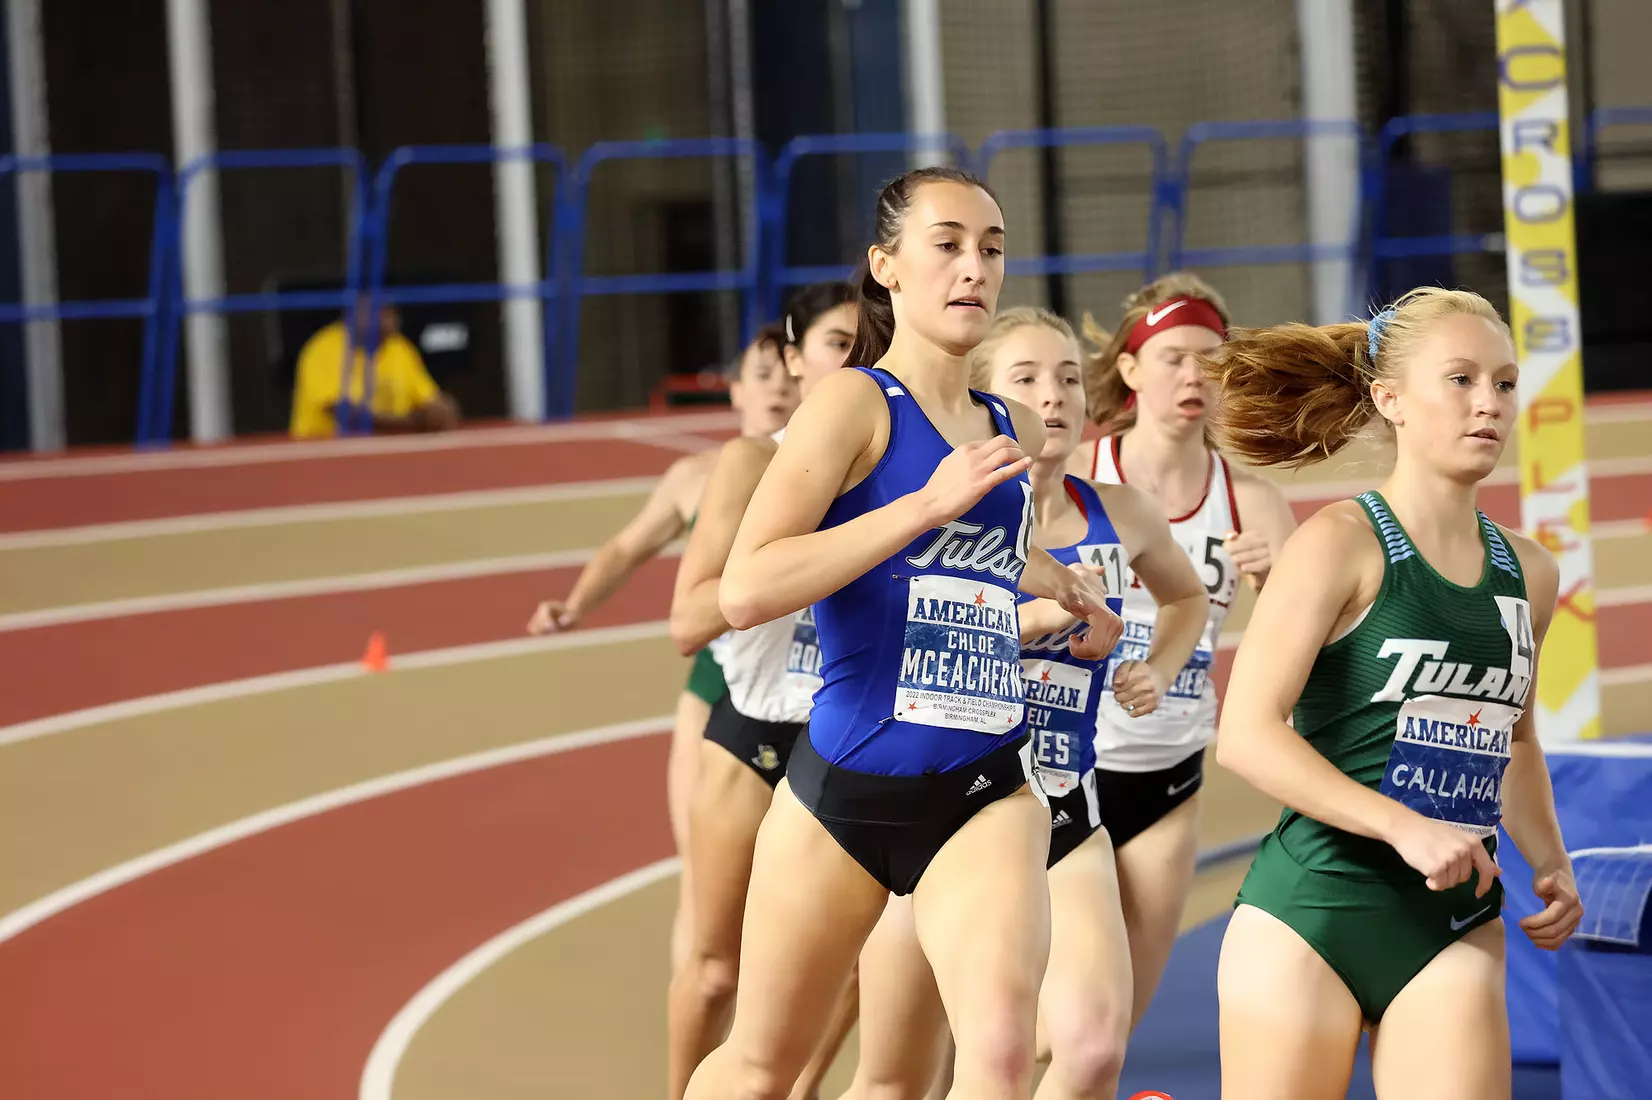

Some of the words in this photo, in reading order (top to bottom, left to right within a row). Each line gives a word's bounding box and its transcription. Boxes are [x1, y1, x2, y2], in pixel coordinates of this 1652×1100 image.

[1091, 548, 1122, 595] 11
[913, 597, 1014, 635] AMERICAN
[947, 630, 996, 655] CHLOE
[899, 647, 1023, 699] MCEACHERN
[905, 690, 919, 699] 2022
[920, 692, 942, 702] INDOOR
[943, 695, 962, 705] TRACK
[967, 698, 982, 707] FIELD
[1022, 678, 1081, 709] RICAN
[968, 706, 996, 718] CROSSPLEX
[1031, 728, 1070, 765] ES
[1402, 716, 1509, 754] AMERICAN
[965, 779, 992, 796] adidas
